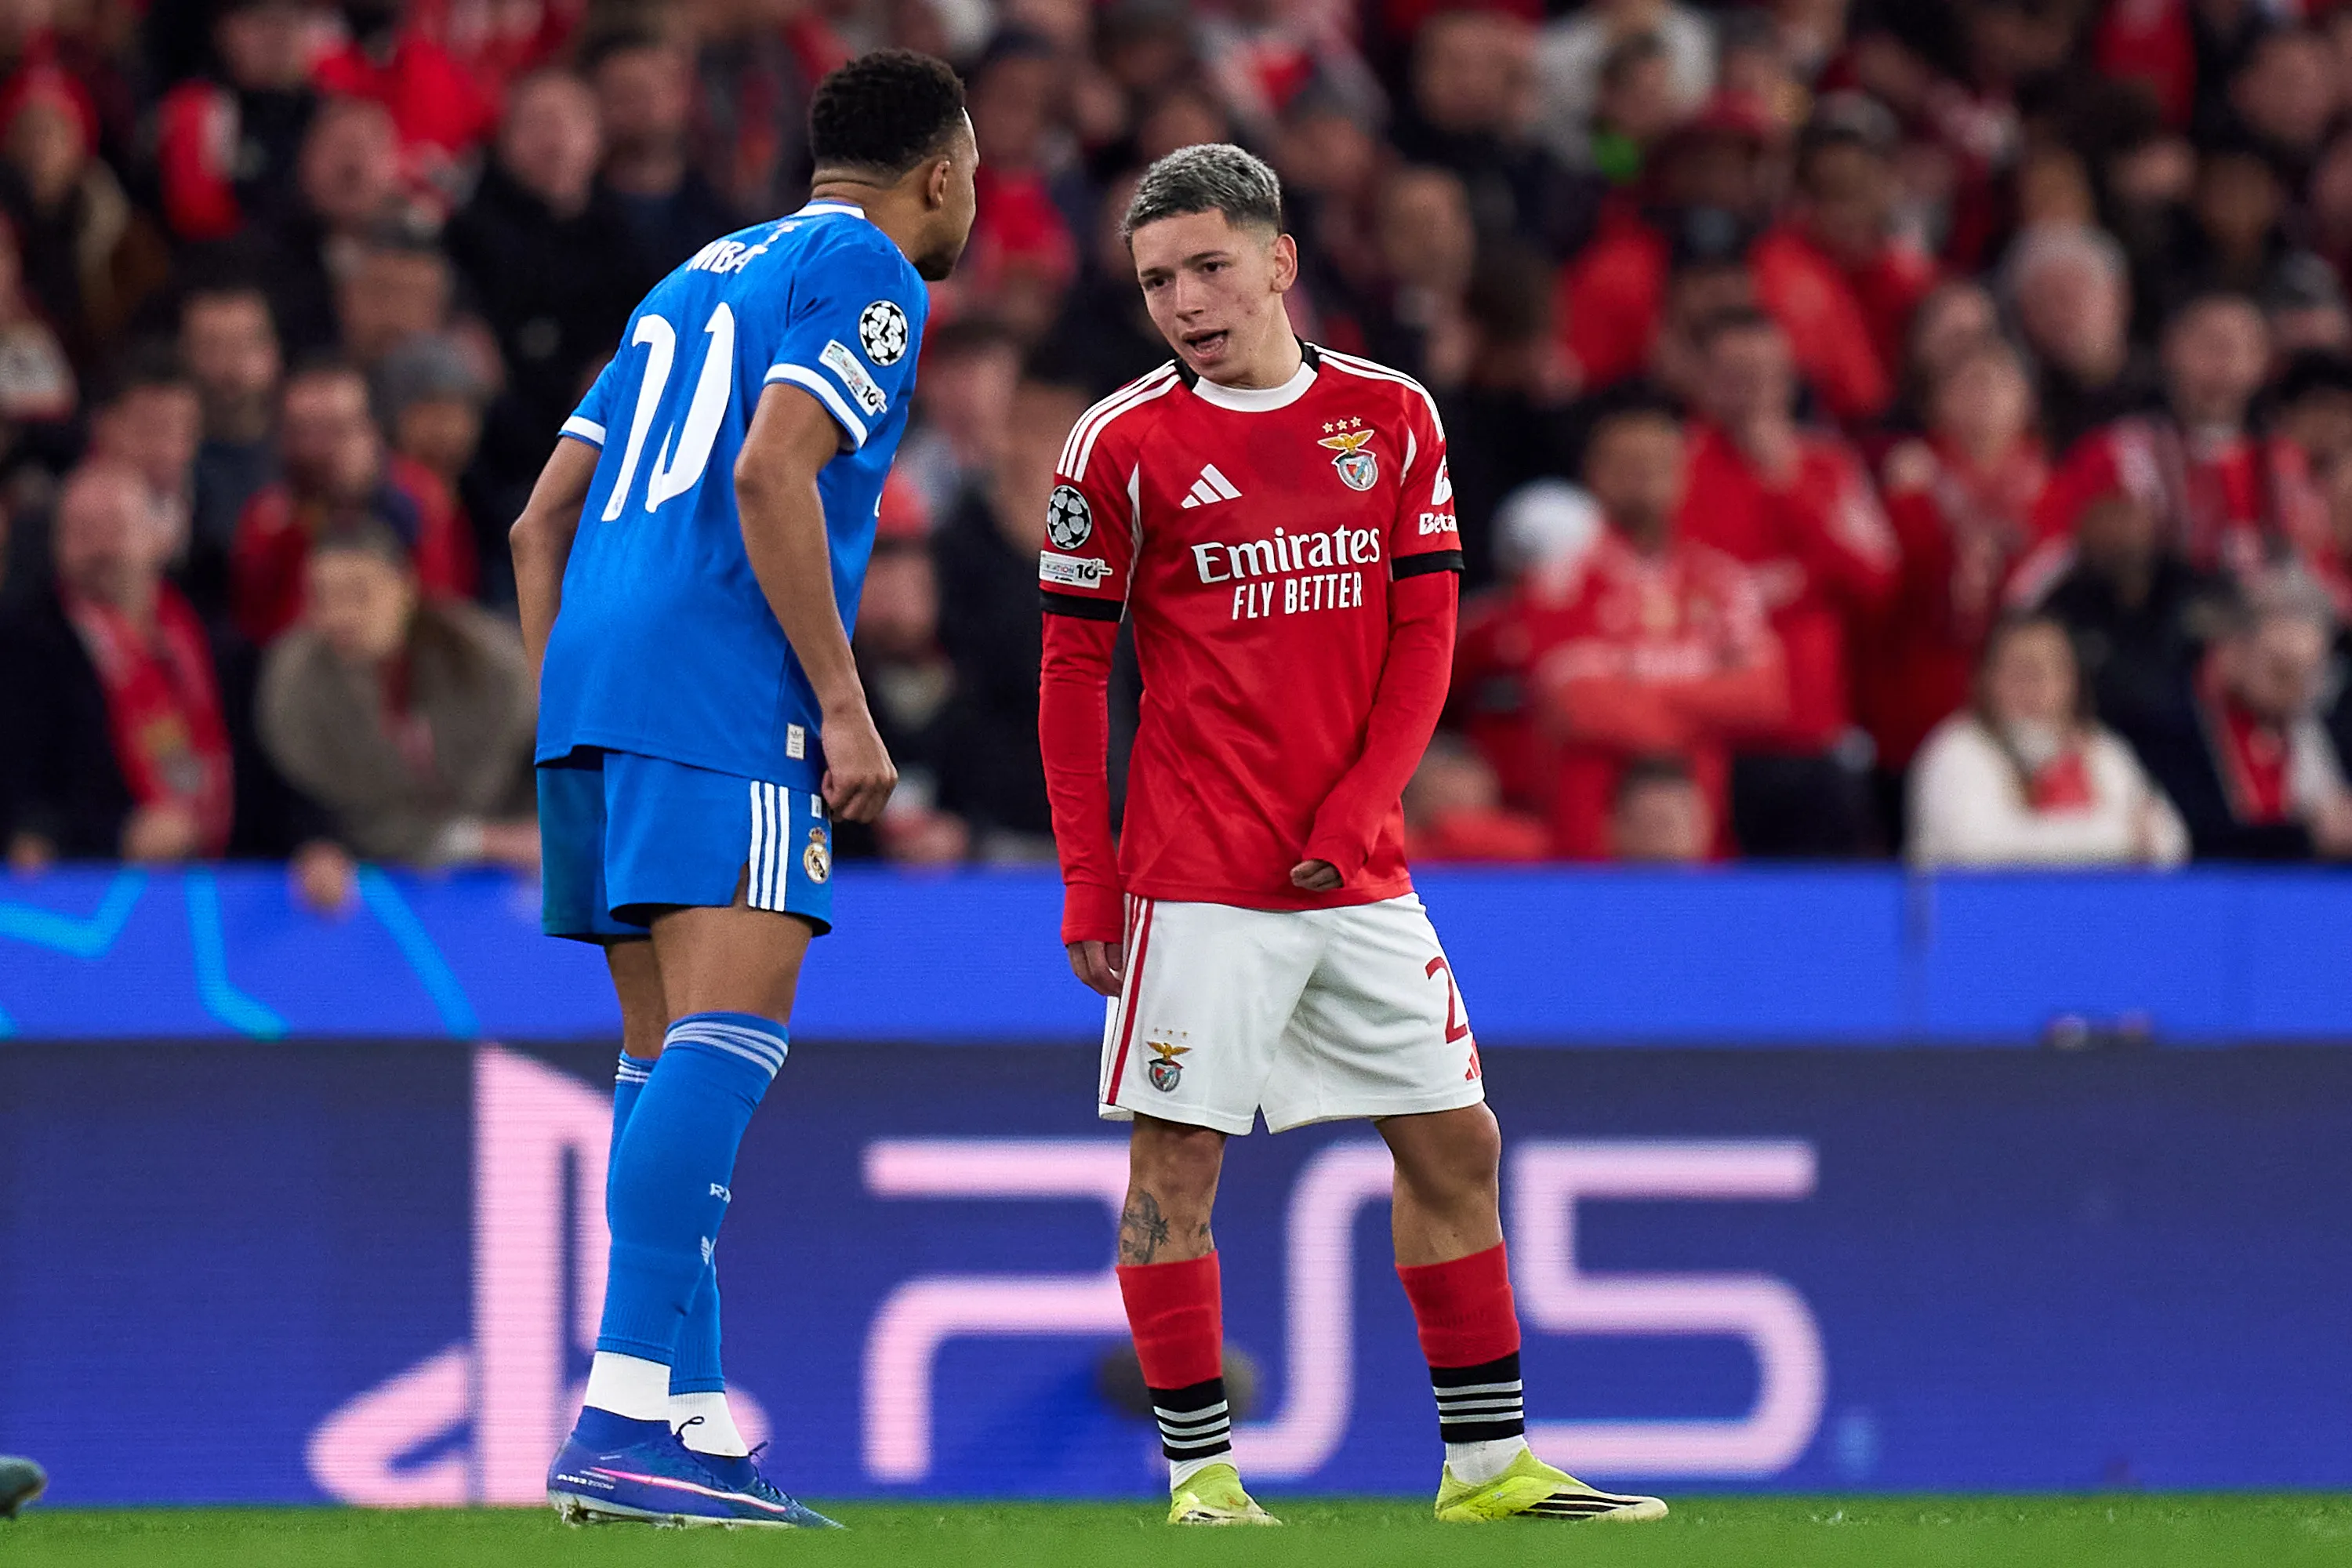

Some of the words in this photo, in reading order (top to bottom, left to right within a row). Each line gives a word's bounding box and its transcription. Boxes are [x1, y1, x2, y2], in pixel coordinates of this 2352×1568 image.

[1419, 513, 1458, 535] Beta
[1076, 564, 1098, 580] 10
[1191, 524, 1380, 583] Emirates
[1232, 581, 1275, 620] FLY
[1284, 572, 1362, 614] BETTER
[1425, 956, 1468, 1044] 2
[865, 1141, 1827, 1479] PS5
